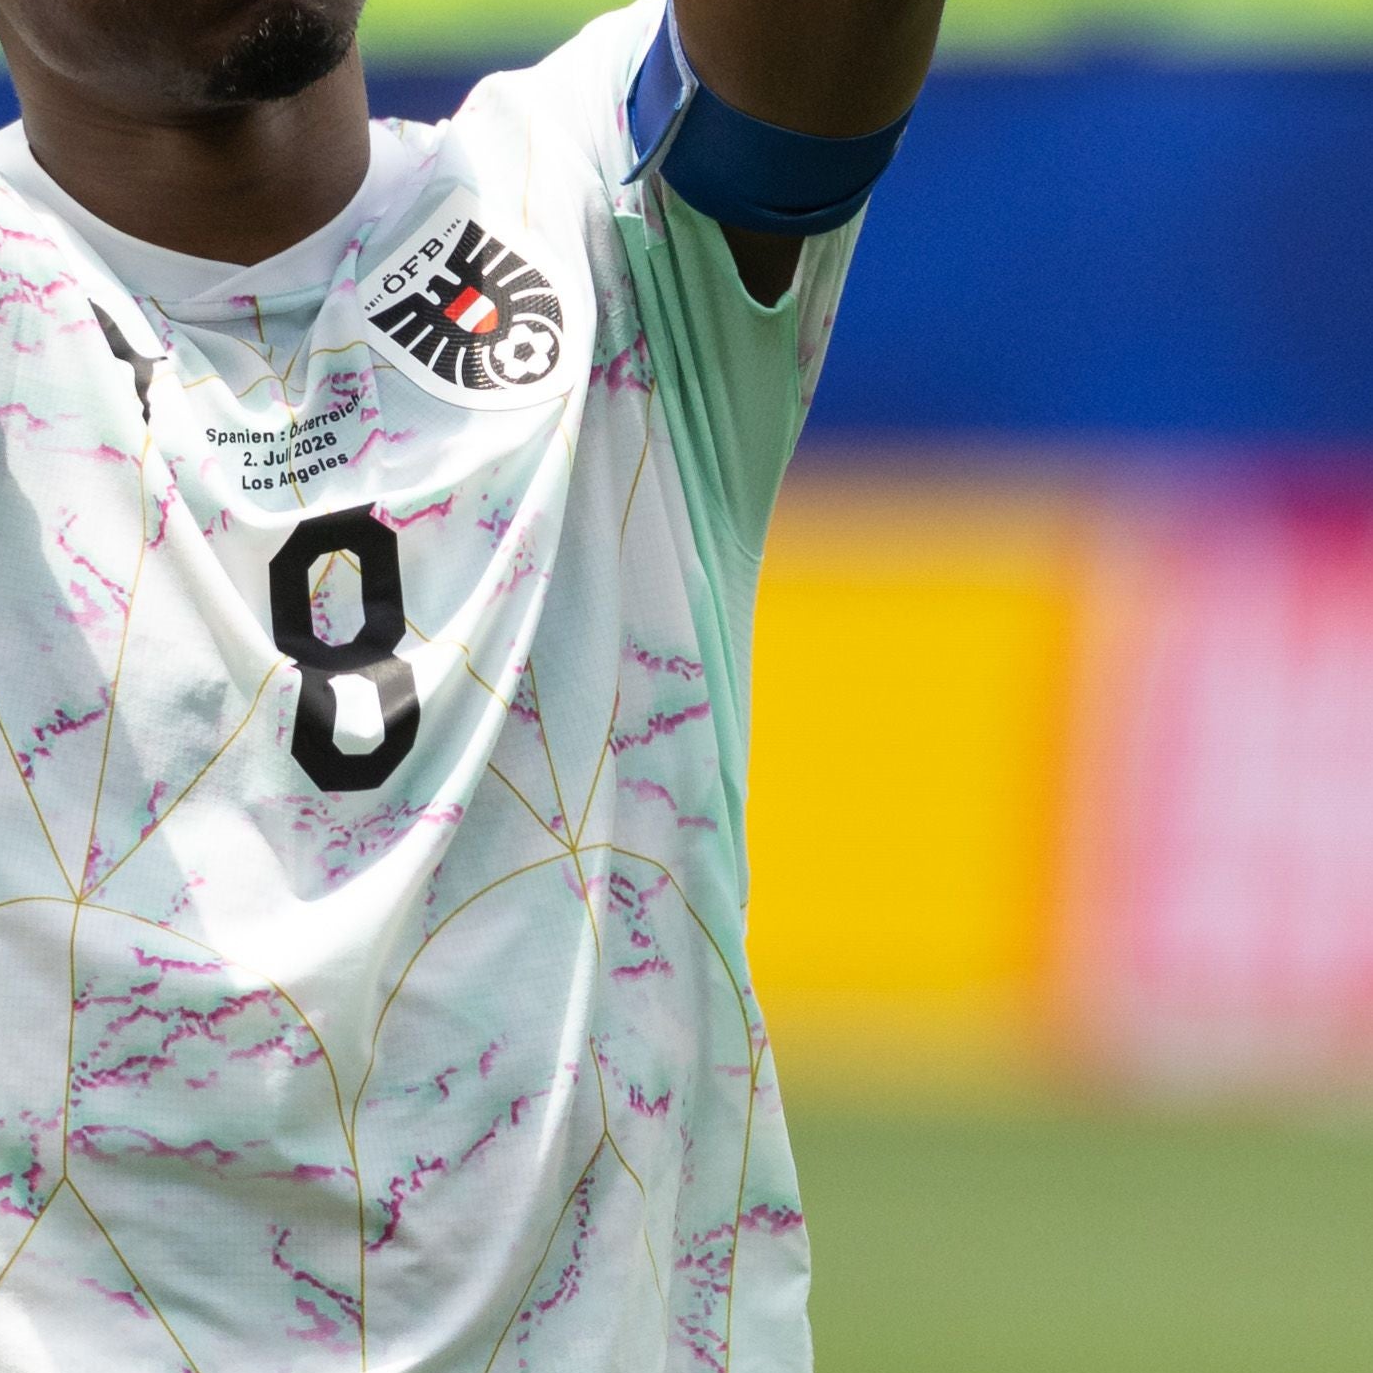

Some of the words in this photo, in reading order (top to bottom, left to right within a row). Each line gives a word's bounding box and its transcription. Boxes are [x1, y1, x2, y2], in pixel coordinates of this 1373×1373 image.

[382, 238, 444, 294] ÖFB
[206, 428, 275, 446] Spanien
[243, 451, 258, 467] 2.
[263, 448, 292, 467] Juli
[294, 431, 338, 458] 2026
[242, 475, 274, 490] Los
[279, 452, 349, 487] Angeles
[269, 502, 421, 792] 8
